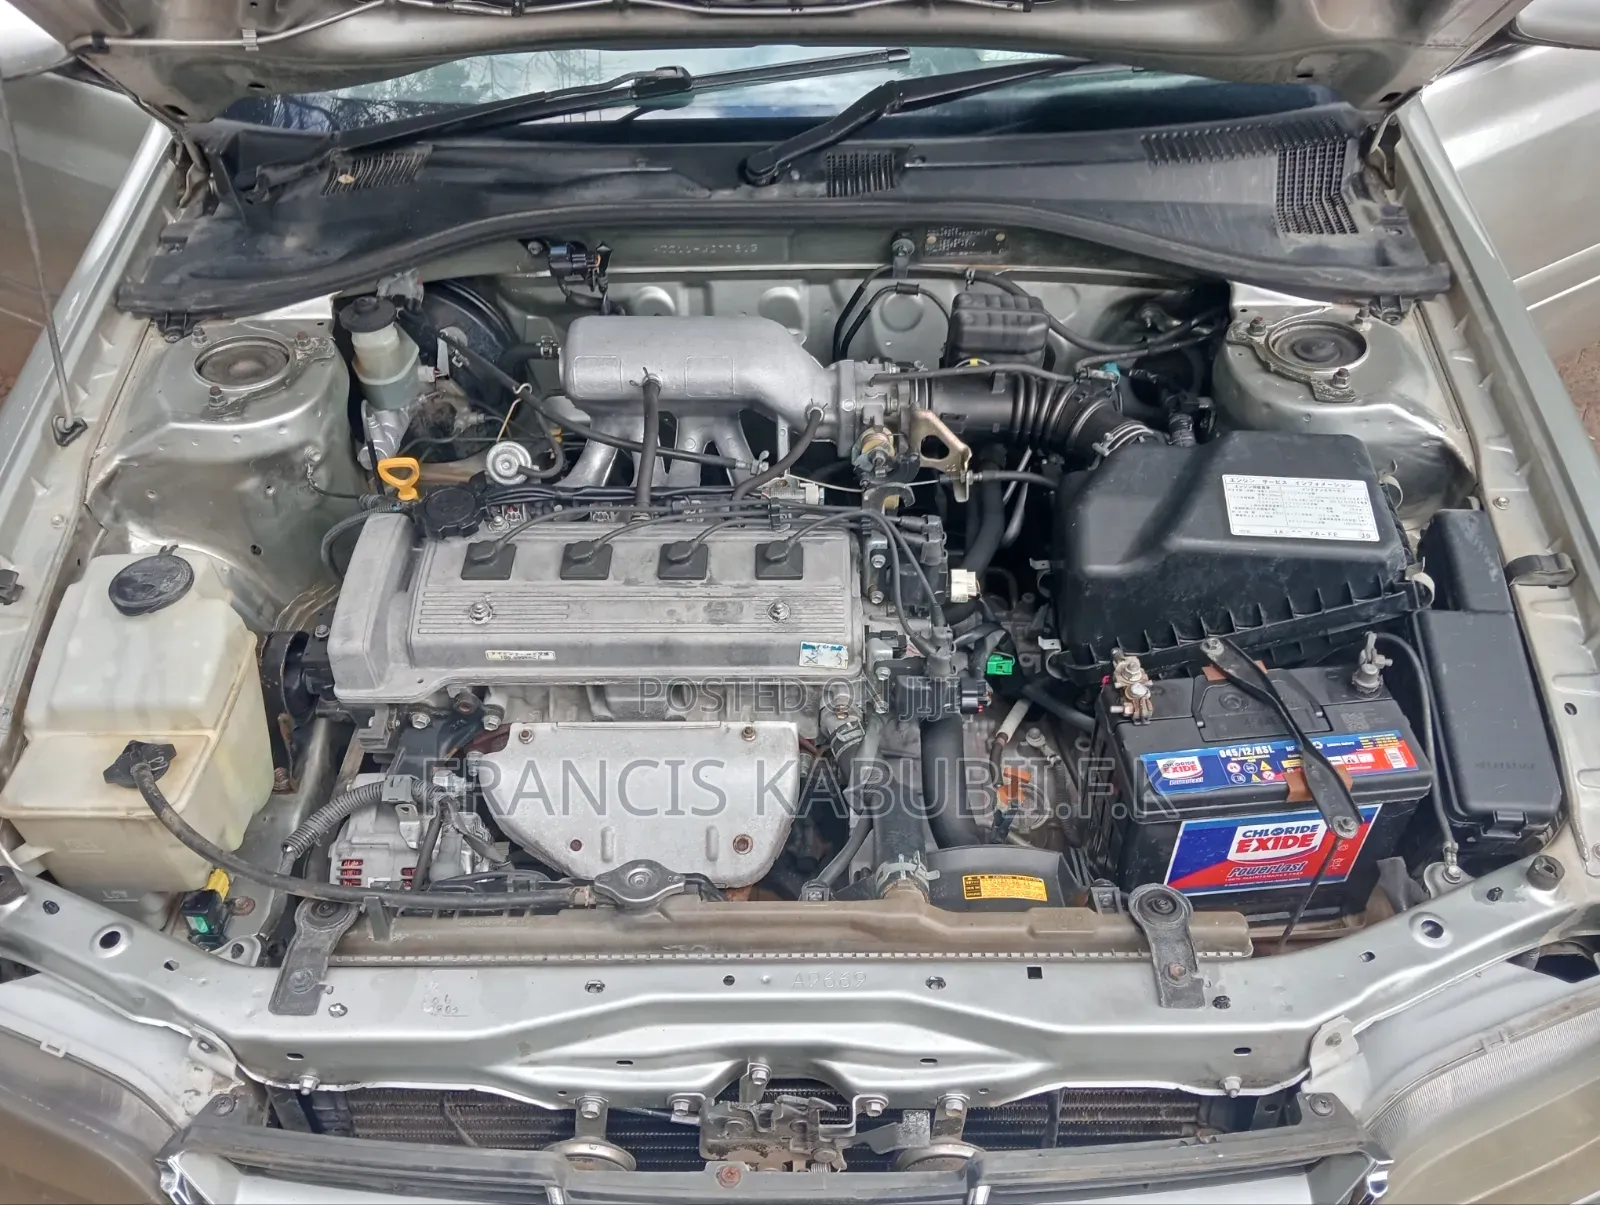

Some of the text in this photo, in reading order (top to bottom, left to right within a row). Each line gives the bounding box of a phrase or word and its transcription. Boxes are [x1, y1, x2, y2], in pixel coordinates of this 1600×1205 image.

[1162, 764, 1198, 774] EXIDE
[1242, 823, 1320, 838] CHLORIDE
[1235, 833, 1318, 854] EXIDE
